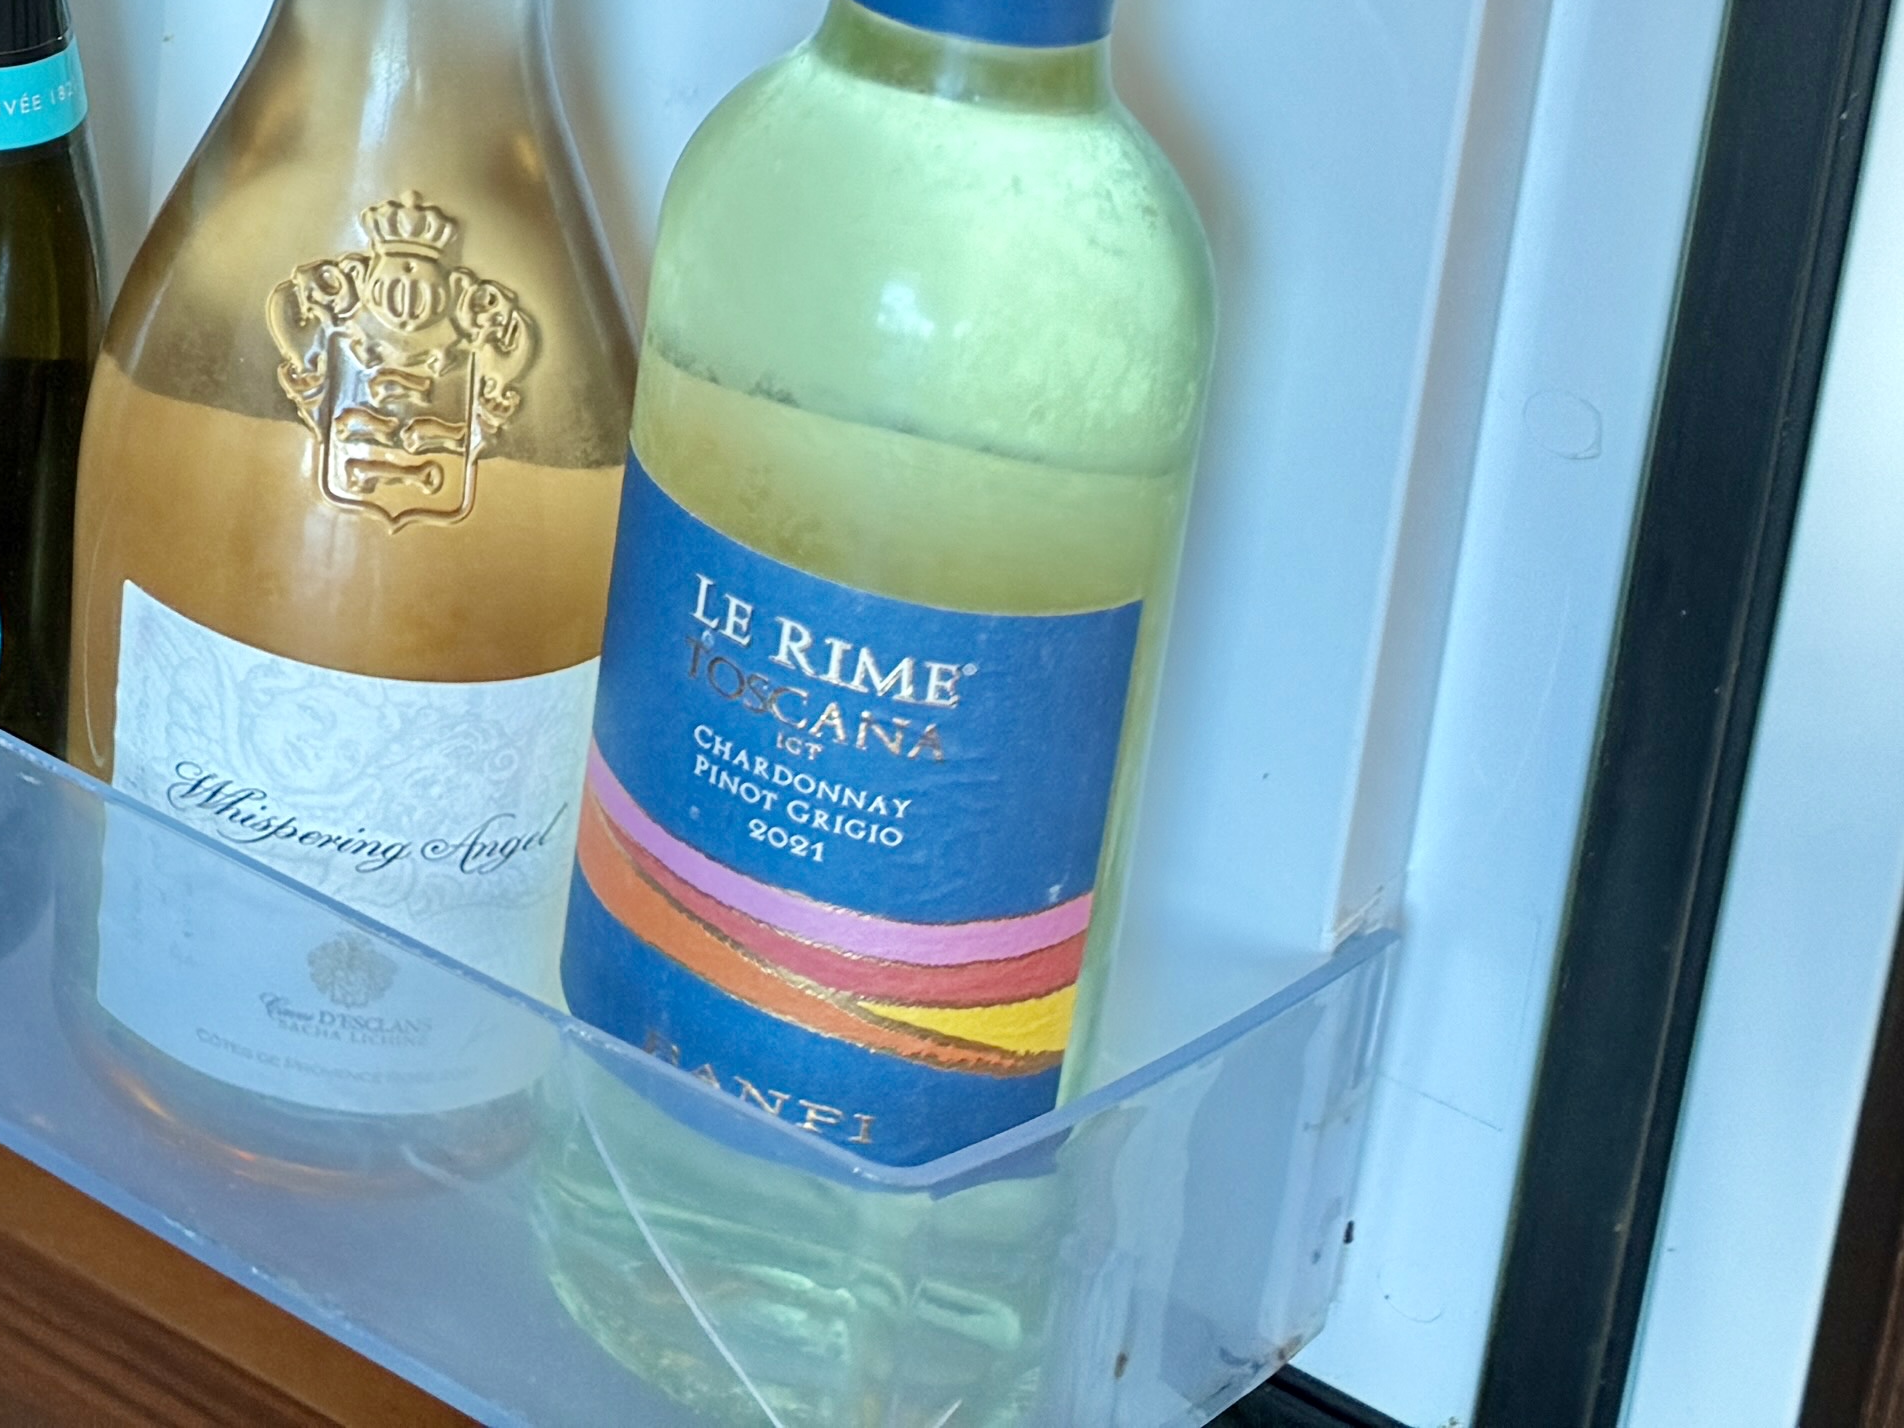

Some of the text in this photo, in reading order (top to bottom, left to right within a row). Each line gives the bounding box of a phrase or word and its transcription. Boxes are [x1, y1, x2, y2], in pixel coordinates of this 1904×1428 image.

[691, 572, 964, 708] LE RIME
[684, 634, 946, 763] TOSCANA
[776, 730, 824, 760] IGT
[167, 760, 569, 874] Whispering Angel
[693, 724, 913, 819] CHARDONNAY
[693, 760, 905, 848] PINOT GRIGIO
[747, 818, 825, 863] 2021
